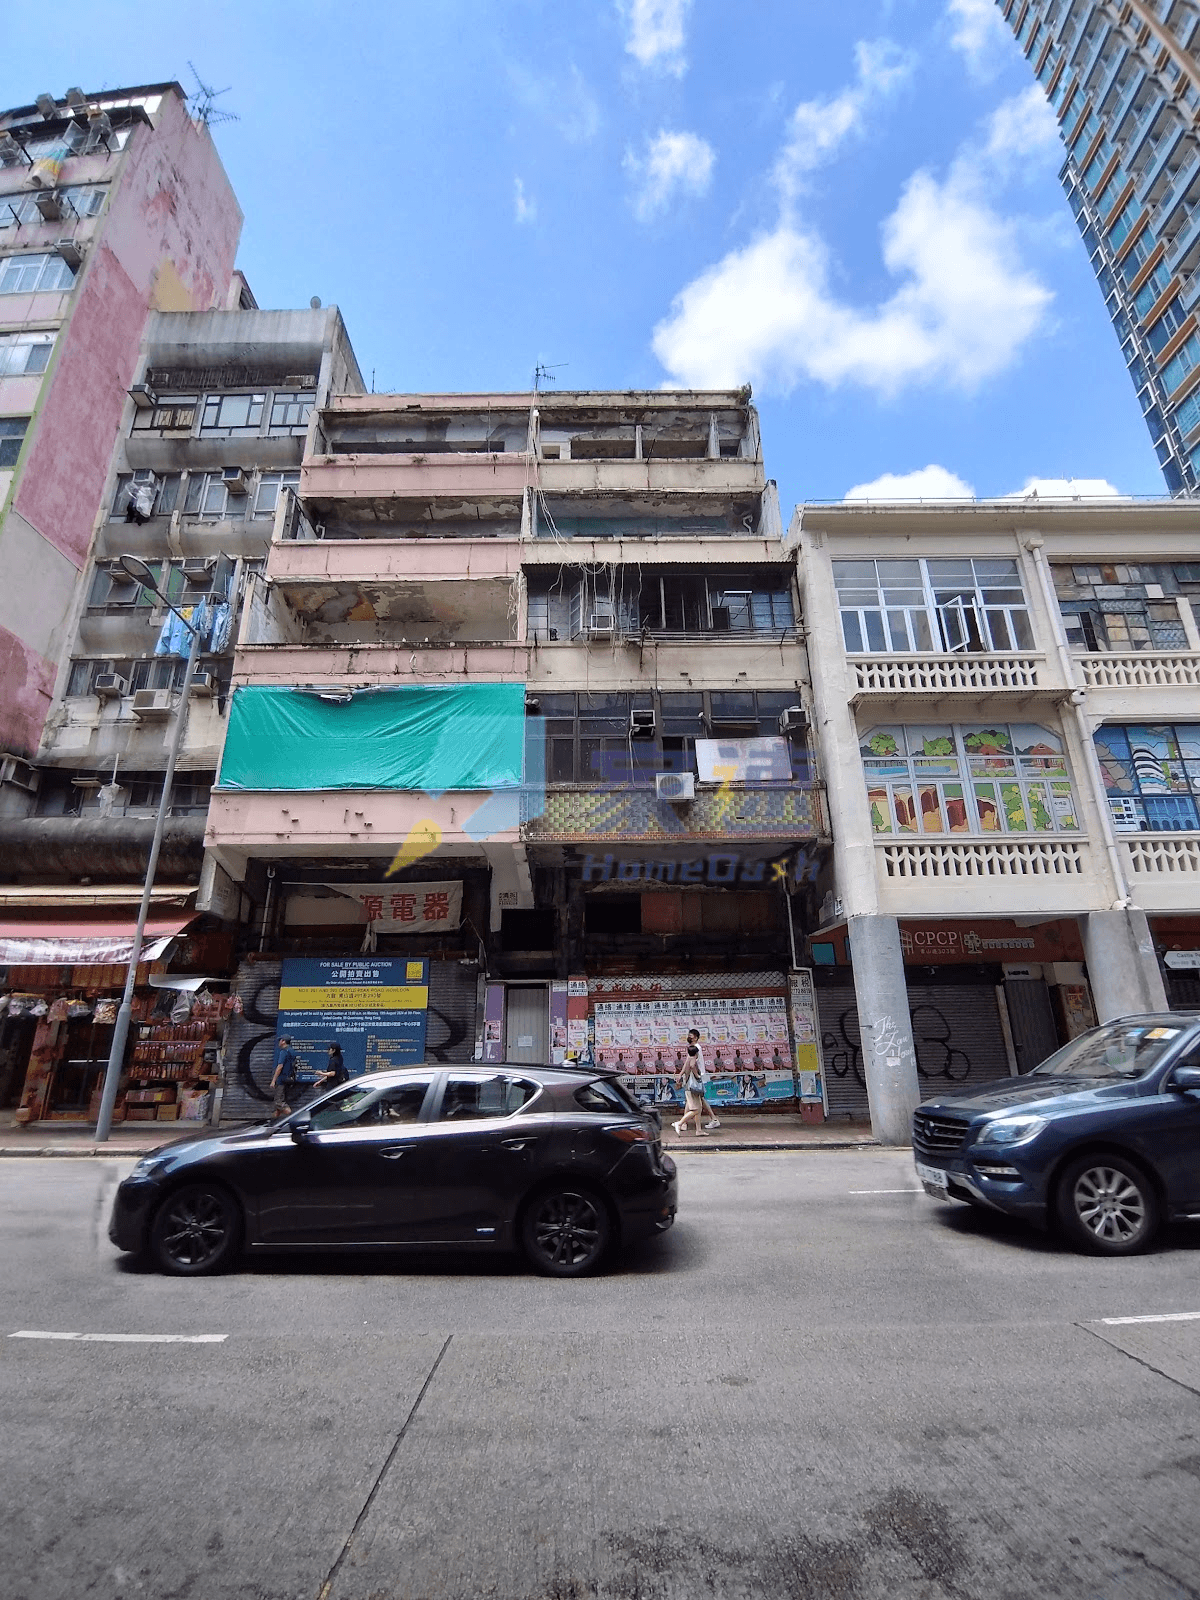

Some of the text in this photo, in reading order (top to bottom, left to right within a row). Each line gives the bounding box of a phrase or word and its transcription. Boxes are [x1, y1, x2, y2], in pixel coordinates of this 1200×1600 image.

[359, 892, 450, 922] 源電器
[914, 931, 958, 945] CPCP
[331, 970, 380, 978] 公開拍賣出售
